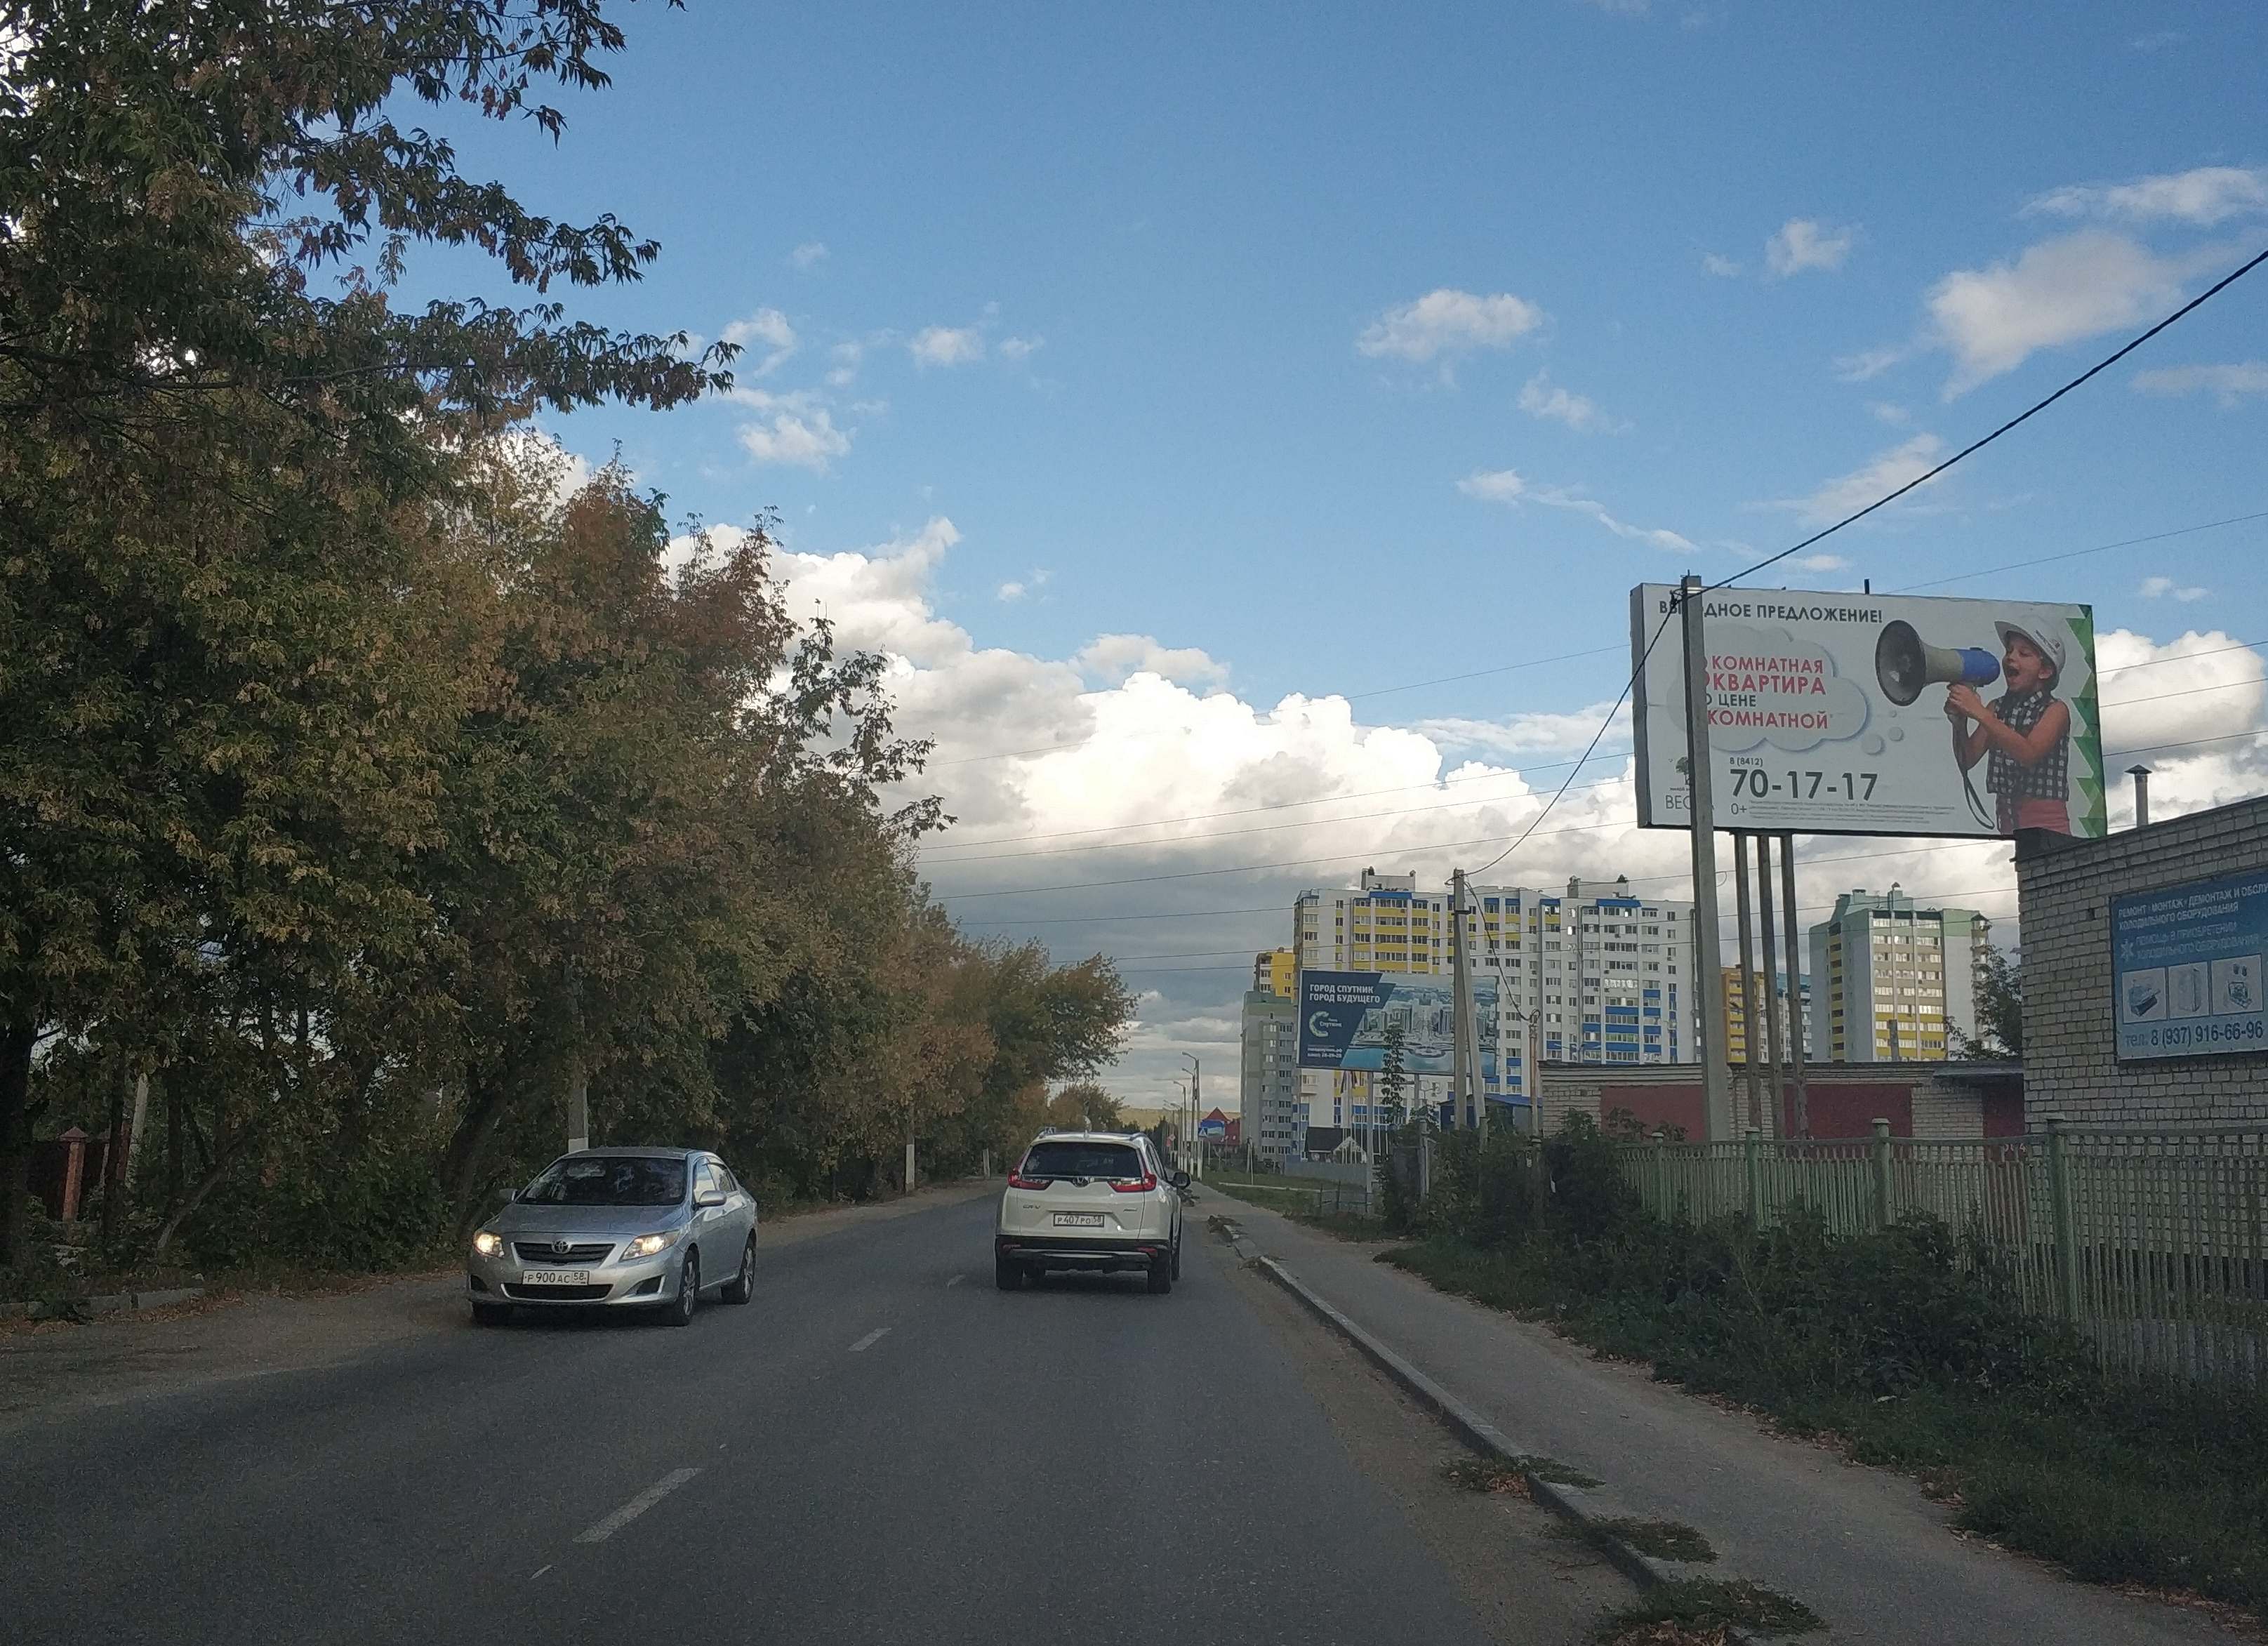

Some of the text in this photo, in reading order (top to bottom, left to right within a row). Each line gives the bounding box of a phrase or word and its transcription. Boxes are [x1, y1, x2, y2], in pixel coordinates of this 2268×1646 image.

[1659, 600, 1883, 623] ВЫДНОЕ ПРЕДЛОЖЕНИЕ!
[1711, 655, 1824, 674] КОМНАТНАЯ
[1713, 673, 1826, 695] КВАРТИРА
[1718, 693, 1756, 708] ЦЕНЕ
[1737, 757, 1763, 767] (8412)
[1730, 769, 1878, 802] 70-17-17
[1730, 803, 1747, 815] 0+
[2118, 905, 2147, 918] РЕМОНТ
[2188, 889, 2232, 907] ДЕМОНТАЖ
[2177, 901, 2239, 920] ОБОРУДОВАНИЯ
[1309, 993, 1381, 1004] ГОРОД БУДУЩЕГО
[1310, 984, 1374, 995] ГОРОД СПУТНИК
[2151, 1030, 2158, 1045] 8
[2162, 1026, 2191, 1048] (937)
[2195, 1021, 2264, 1043] 916-66-96
